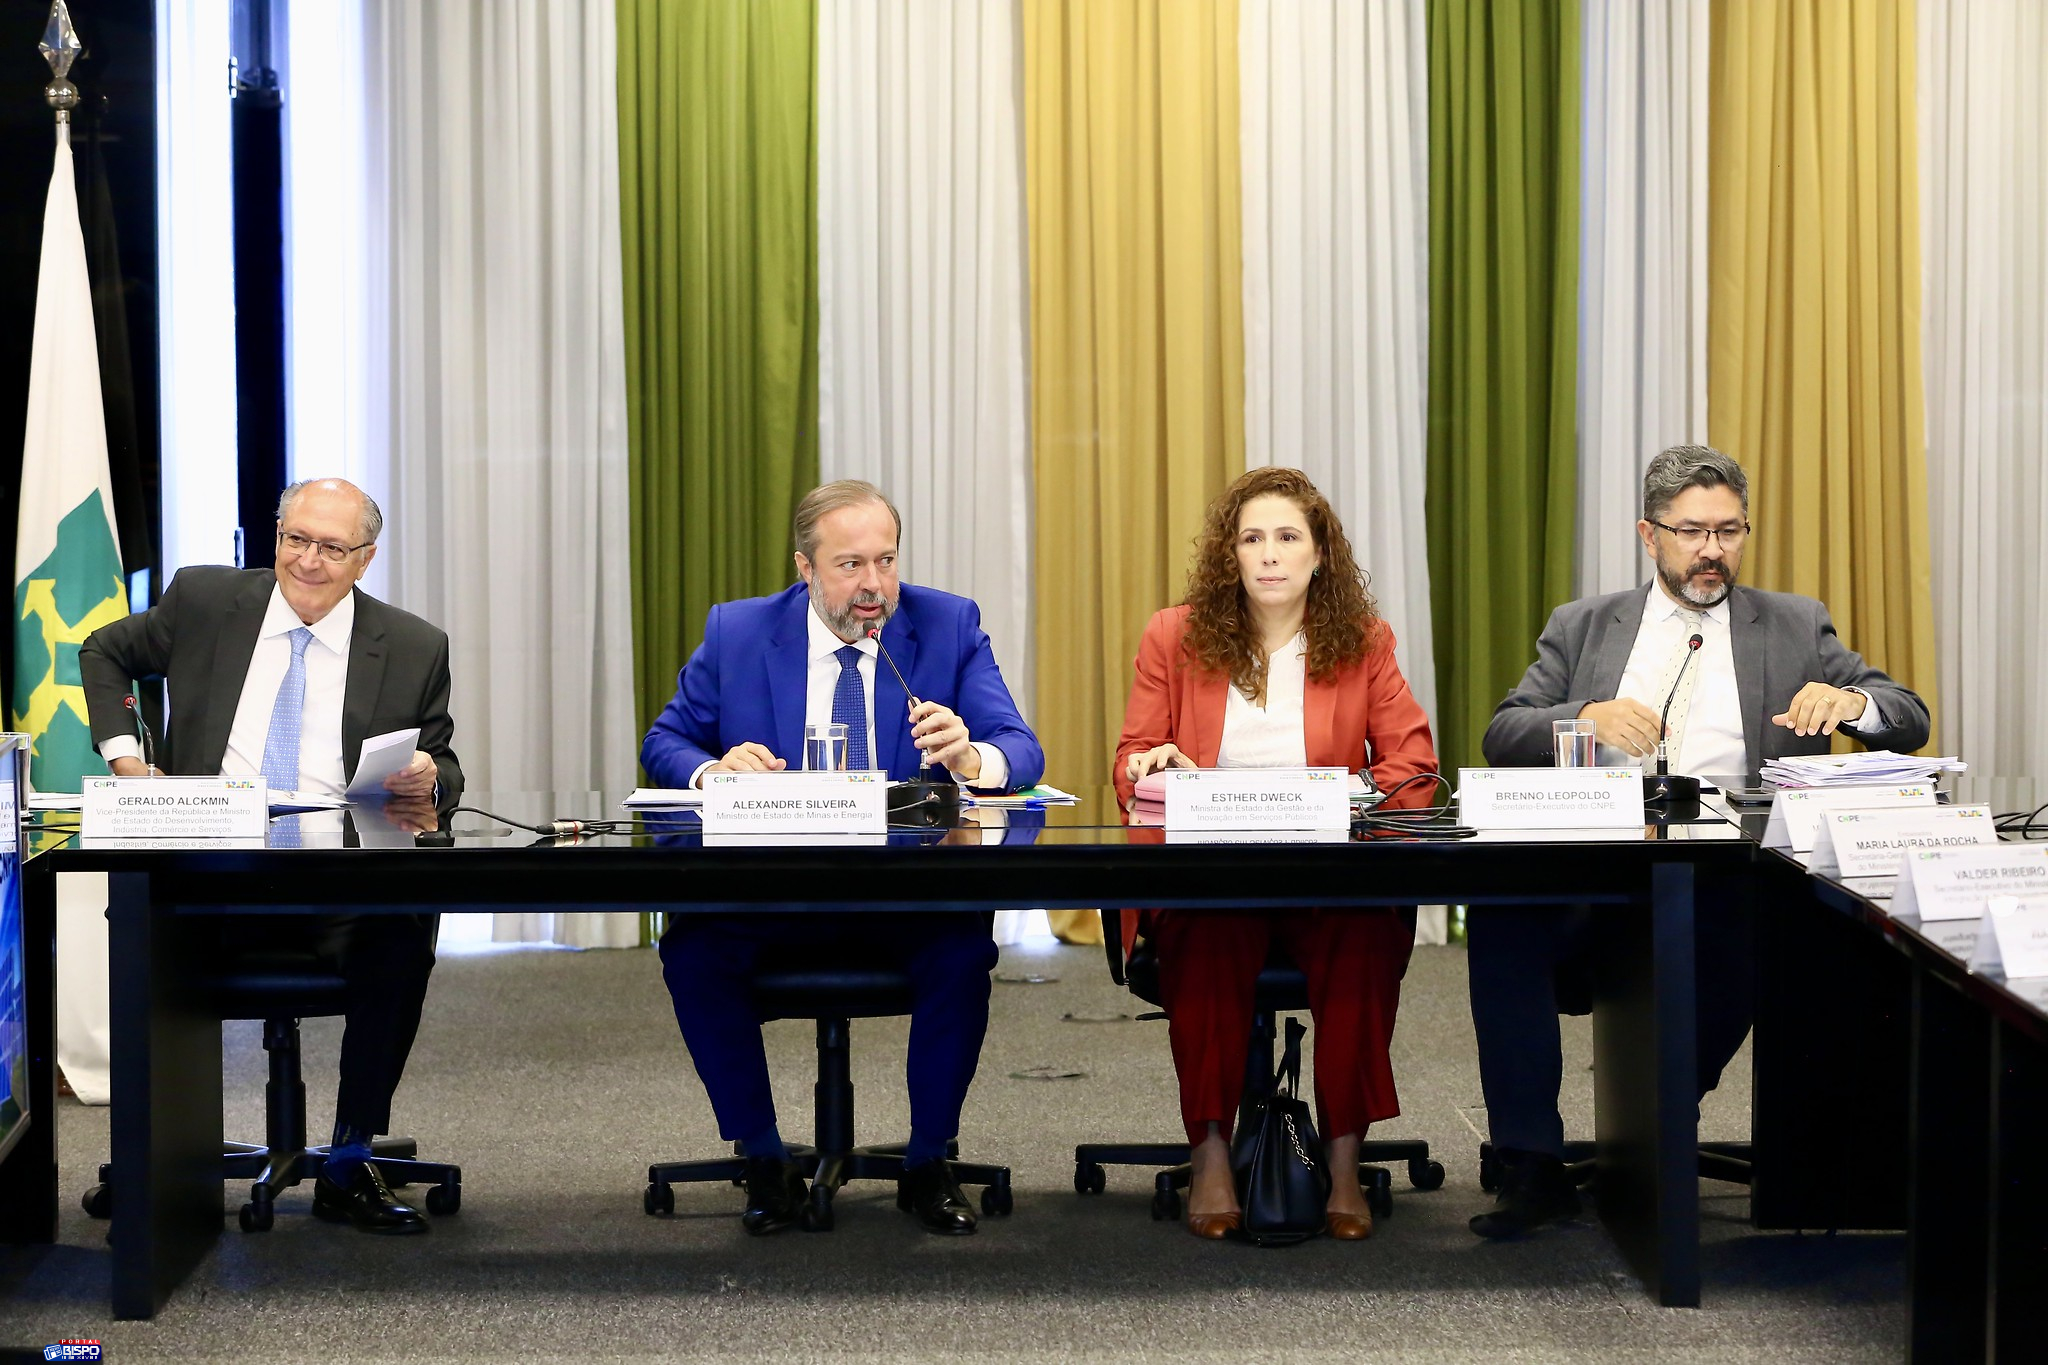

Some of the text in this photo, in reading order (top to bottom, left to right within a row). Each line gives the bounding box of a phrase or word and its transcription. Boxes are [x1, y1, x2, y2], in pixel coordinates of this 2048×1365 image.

[1212, 793, 1303, 802] ESTHER DWECK
[1496, 791, 1610, 801] BRENNO LEOPOLDO
[118, 797, 229, 806] GERALDO ALCKMIN
[732, 799, 857, 810] ALEXANDRE SILVEIRA
[1491, 802, 1615, 811] Secretário-Executivo do CNPE
[96, 808, 157, 816] Vice-Presidente
[159, 808, 170, 816] da
[172, 807, 211, 817] República
[220, 808, 250, 816] Ministro
[1190, 804, 1221, 813] Ministra
[1235, 804, 1262, 812] Estado
[1264, 804, 1275, 812] da
[1277, 803, 1305, 812] Gestão
[111, 817, 121, 825] de
[124, 817, 150, 825] Estado
[153, 817, 163, 825] do
[716, 812, 747, 820] Ministro
[750, 812, 760, 820] de
[763, 811, 792, 820] Estado
[794, 811, 804, 819] de
[806, 811, 831, 819] Minas
[841, 811, 873, 821] Energia
[1197, 814, 1233, 823] Inovação
[1249, 813, 1283, 822] Serviços
[1285, 813, 1318, 821] Públicos
[151, 826, 189, 835] Comércio
[198, 826, 232, 836] Serviços
[1856, 836, 1979, 850] MARIA LAURA DA ROCHA
[1954, 865, 2046, 880] VALDER RIBEIRO
